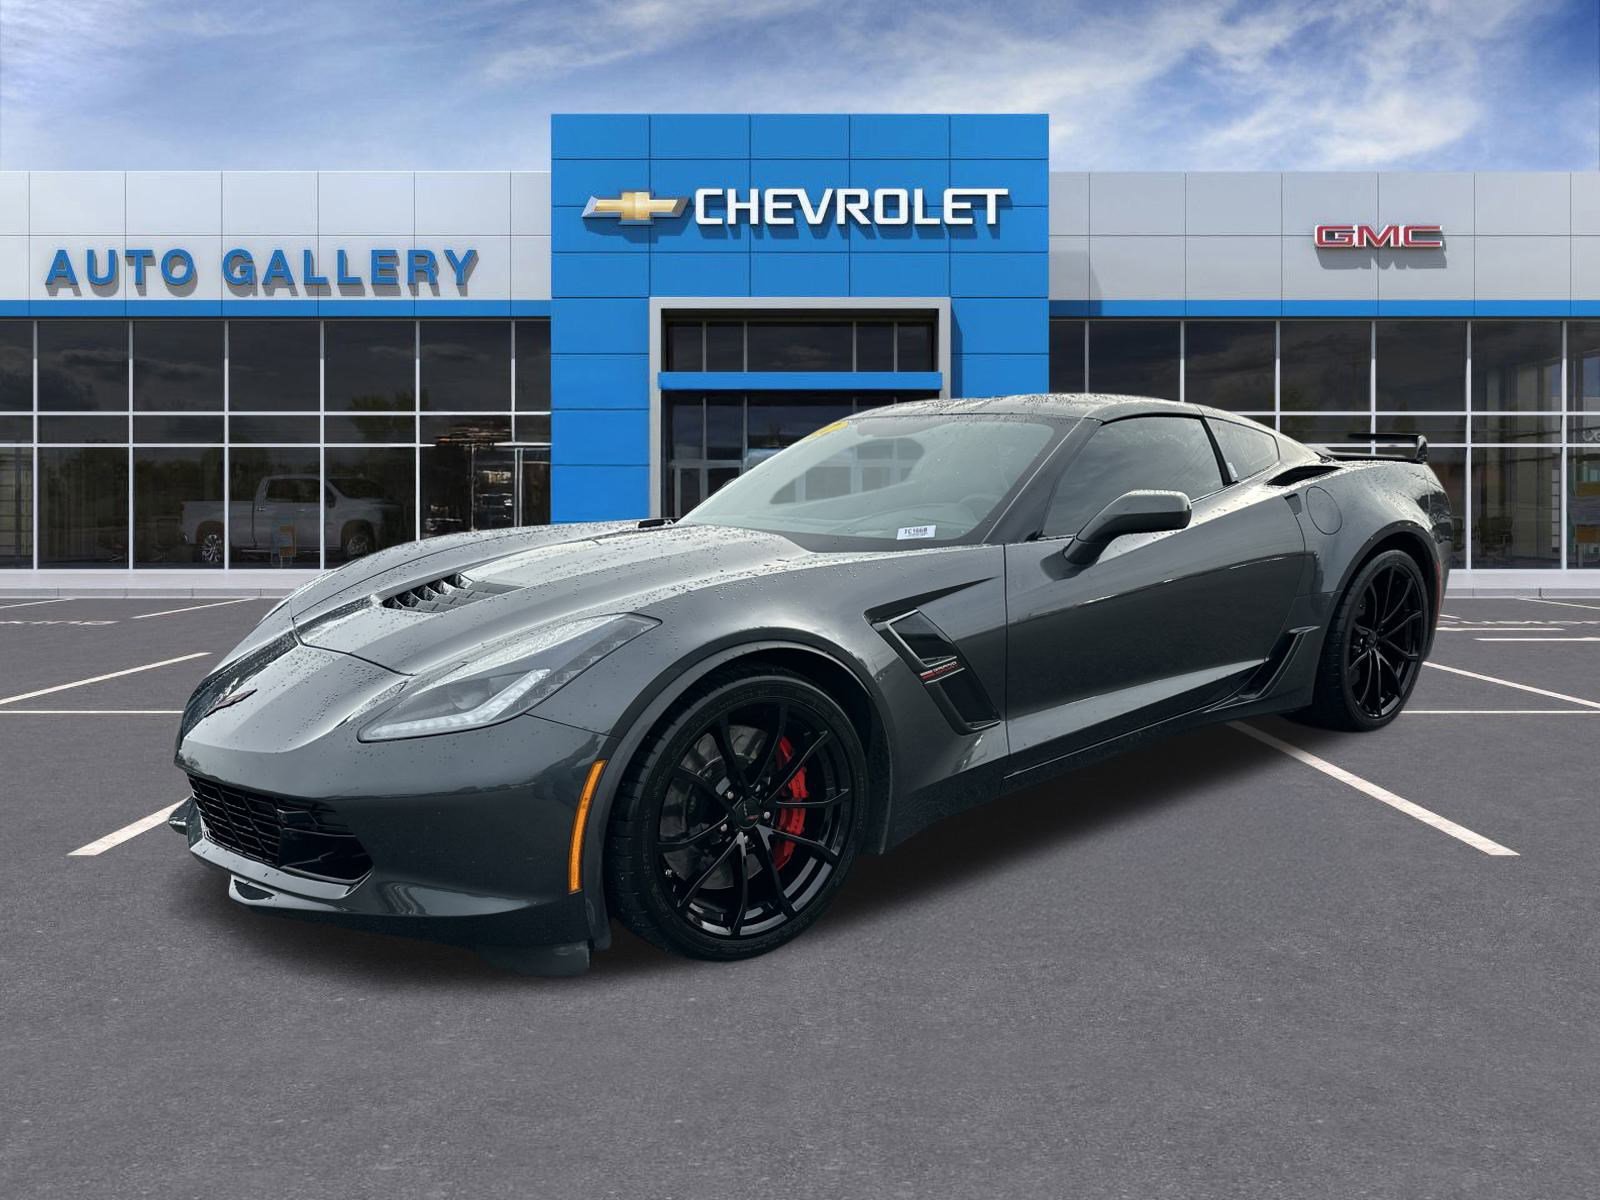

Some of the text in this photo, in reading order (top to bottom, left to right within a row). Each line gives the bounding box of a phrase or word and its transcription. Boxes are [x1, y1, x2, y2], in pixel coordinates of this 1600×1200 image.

[695, 188, 1009, 225] CHEVROLET
[1314, 224, 1443, 248] GMC
[45, 248, 477, 287] AUTO GALLERY
